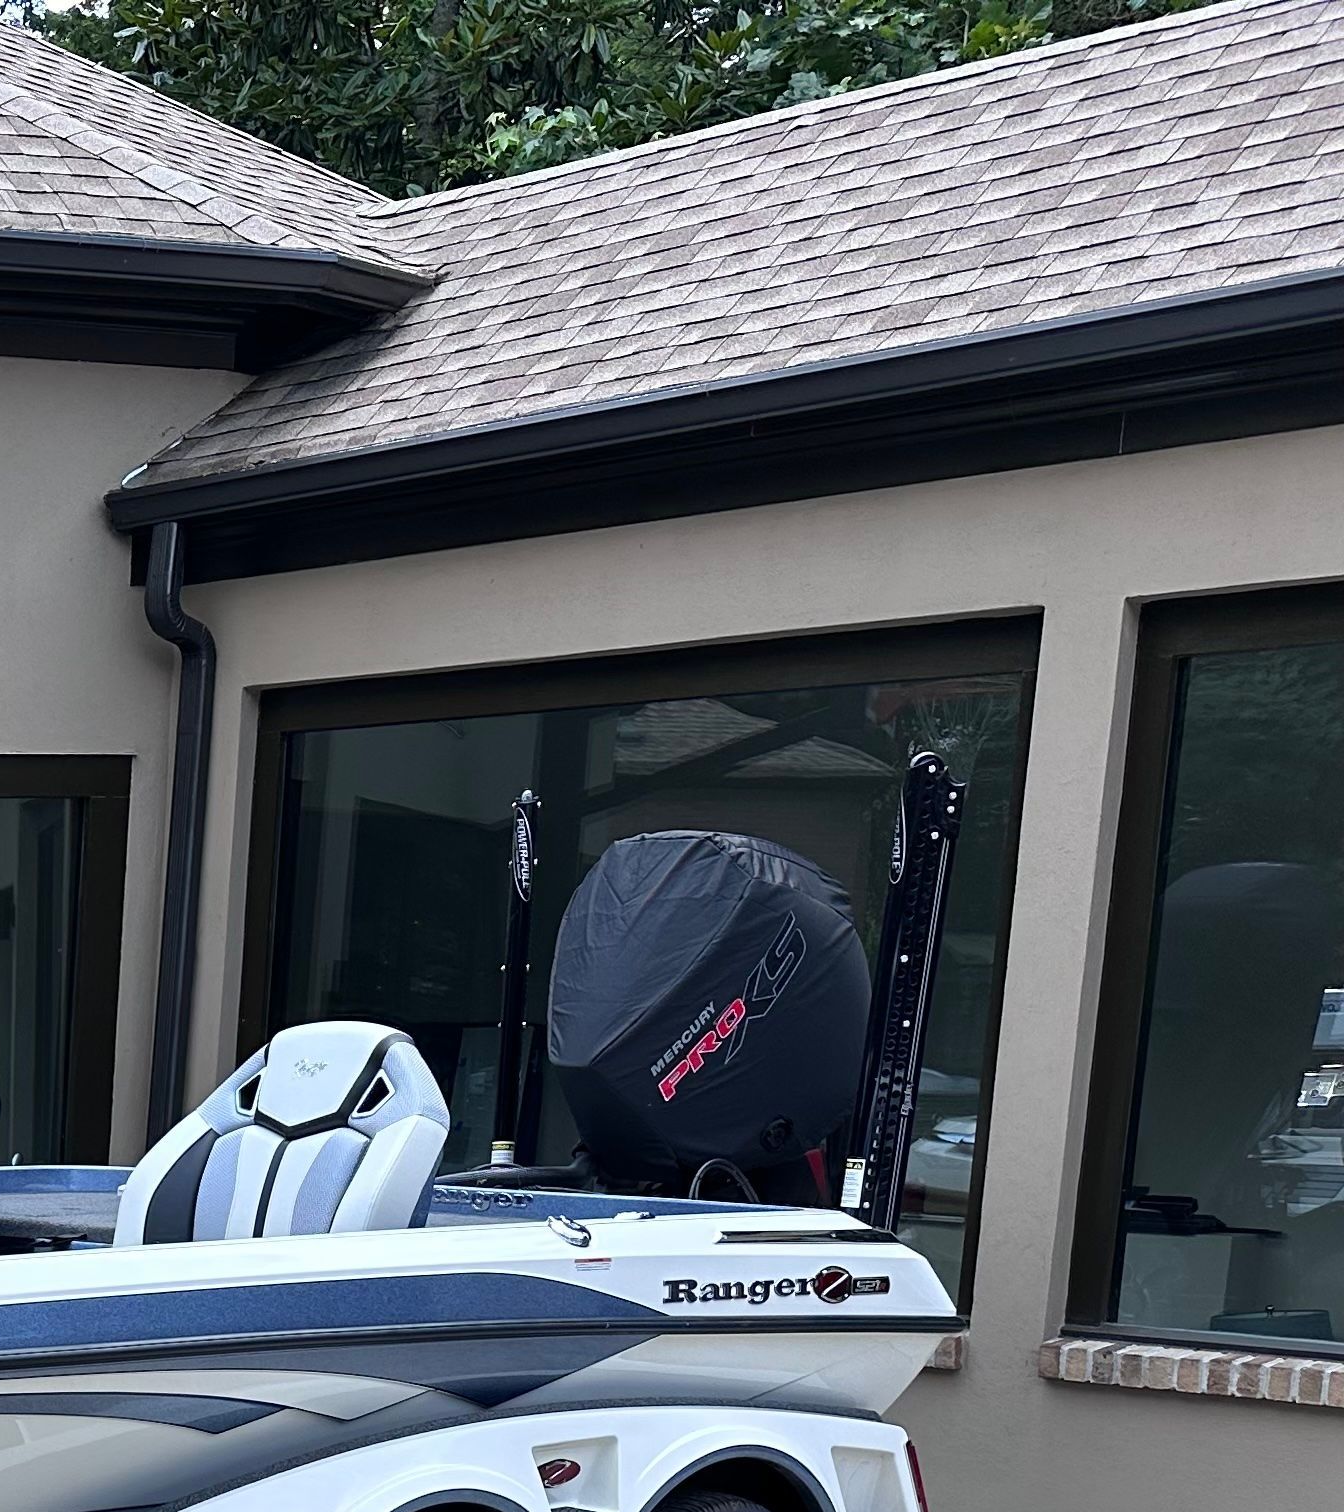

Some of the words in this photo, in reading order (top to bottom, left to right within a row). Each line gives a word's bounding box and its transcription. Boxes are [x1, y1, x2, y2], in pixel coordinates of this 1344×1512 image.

[650, 1001, 716, 1077] MERCURY
[658, 998, 746, 1101] PRO
[433, 1188, 534, 1212] anger
[662, 1276, 817, 1305] Ranger
